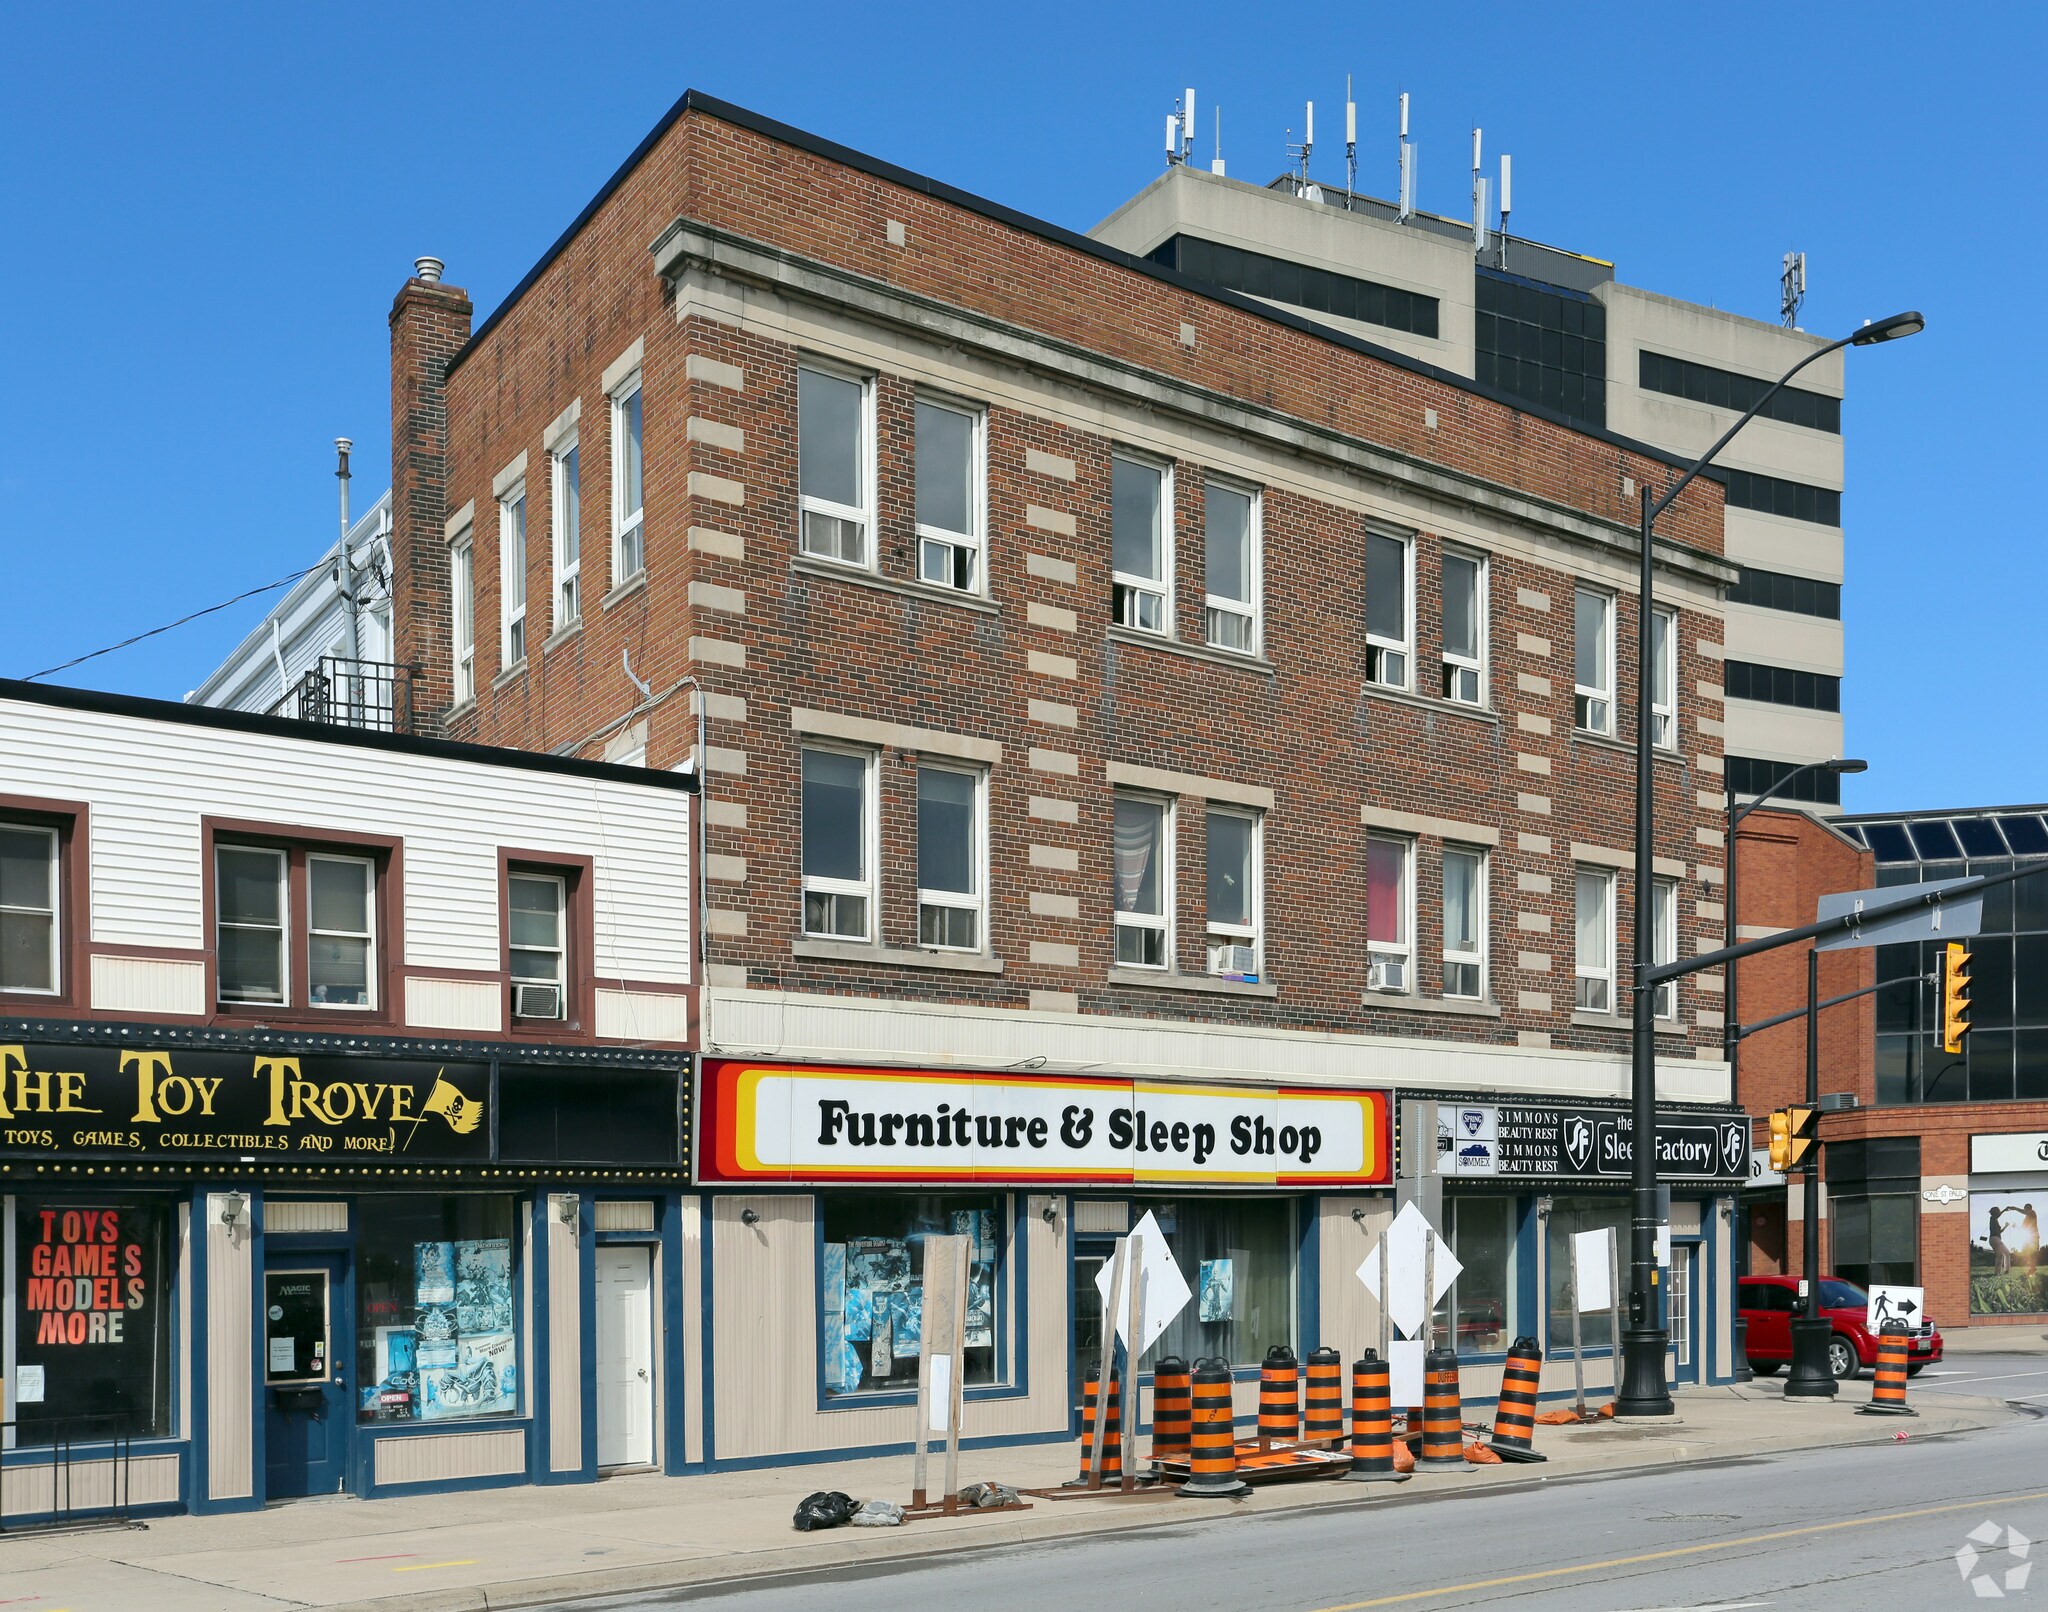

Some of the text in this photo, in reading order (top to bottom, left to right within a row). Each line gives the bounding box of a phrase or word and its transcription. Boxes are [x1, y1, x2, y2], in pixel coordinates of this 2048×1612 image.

[118, 1049, 224, 1124] TOY
[252, 1055, 429, 1127] TROVE
[1497, 1110, 1558, 1124] SIMMONS
[1616, 1115, 1633, 1131] the
[4, 1126, 396, 1155] TOYS, GAMES, COLLECTIBLES AND MORE!
[817, 1098, 1322, 1165] Furniture & Sleep Shop
[1498, 1126, 1558, 1140] BEAUTY REST
[1497, 1143, 1558, 1157] SIMMONS
[1604, 1132, 1712, 1169] Slee Factory
[1498, 1159, 1558, 1172] BEAUTY REST
[39, 1210, 119, 1244] TOYS
[32, 1243, 142, 1277] GAMES
[27, 1277, 145, 1311] MODELS
[366, 1302, 398, 1313] OPEN
[36, 1311, 124, 1345] MORE
[488, 1344, 507, 1357] NOW!
[380, 1394, 402, 1403] OPEN
